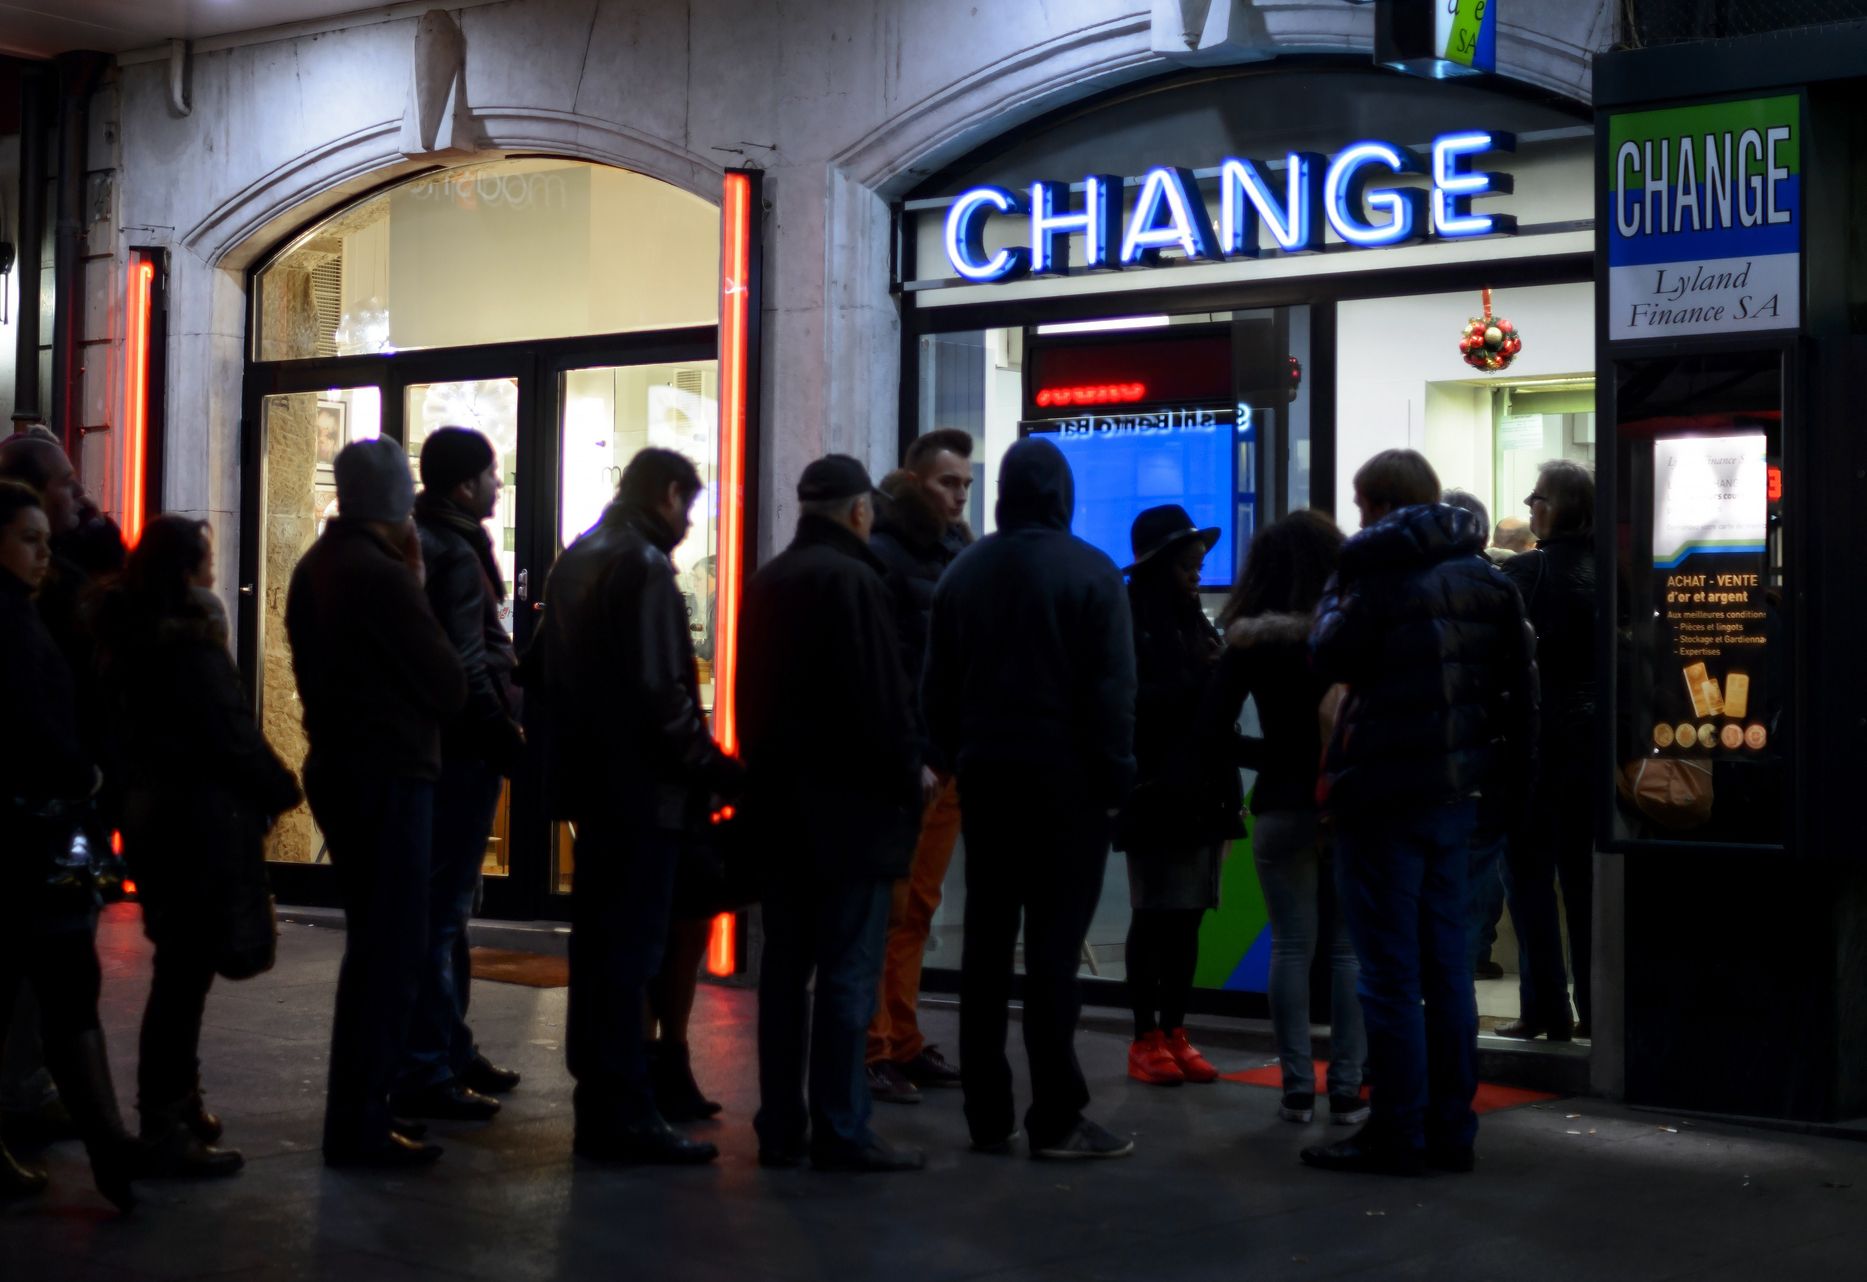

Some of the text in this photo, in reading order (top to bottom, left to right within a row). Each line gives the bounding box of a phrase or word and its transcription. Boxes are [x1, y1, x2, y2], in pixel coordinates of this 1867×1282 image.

[1457, 28, 1477, 57] SA
[1616, 125, 1791, 238] CHANGE
[944, 131, 1512, 283] CHANGE
[1653, 262, 1752, 302] Lyland
[1627, 302, 1725, 328] Finance
[1667, 575, 1706, 587] ACHAT
[1717, 574, 1758, 587] VENTE
[1667, 591, 1748, 604] d'or et argent
[1667, 611, 1682, 619] Aux
[1683, 610, 1725, 619] meilleures
[1707, 622, 1715, 631] et
[1716, 622, 1744, 632] lingots
[1680, 635, 1713, 644] Stockage
[1680, 647, 1721, 657] Expertises
